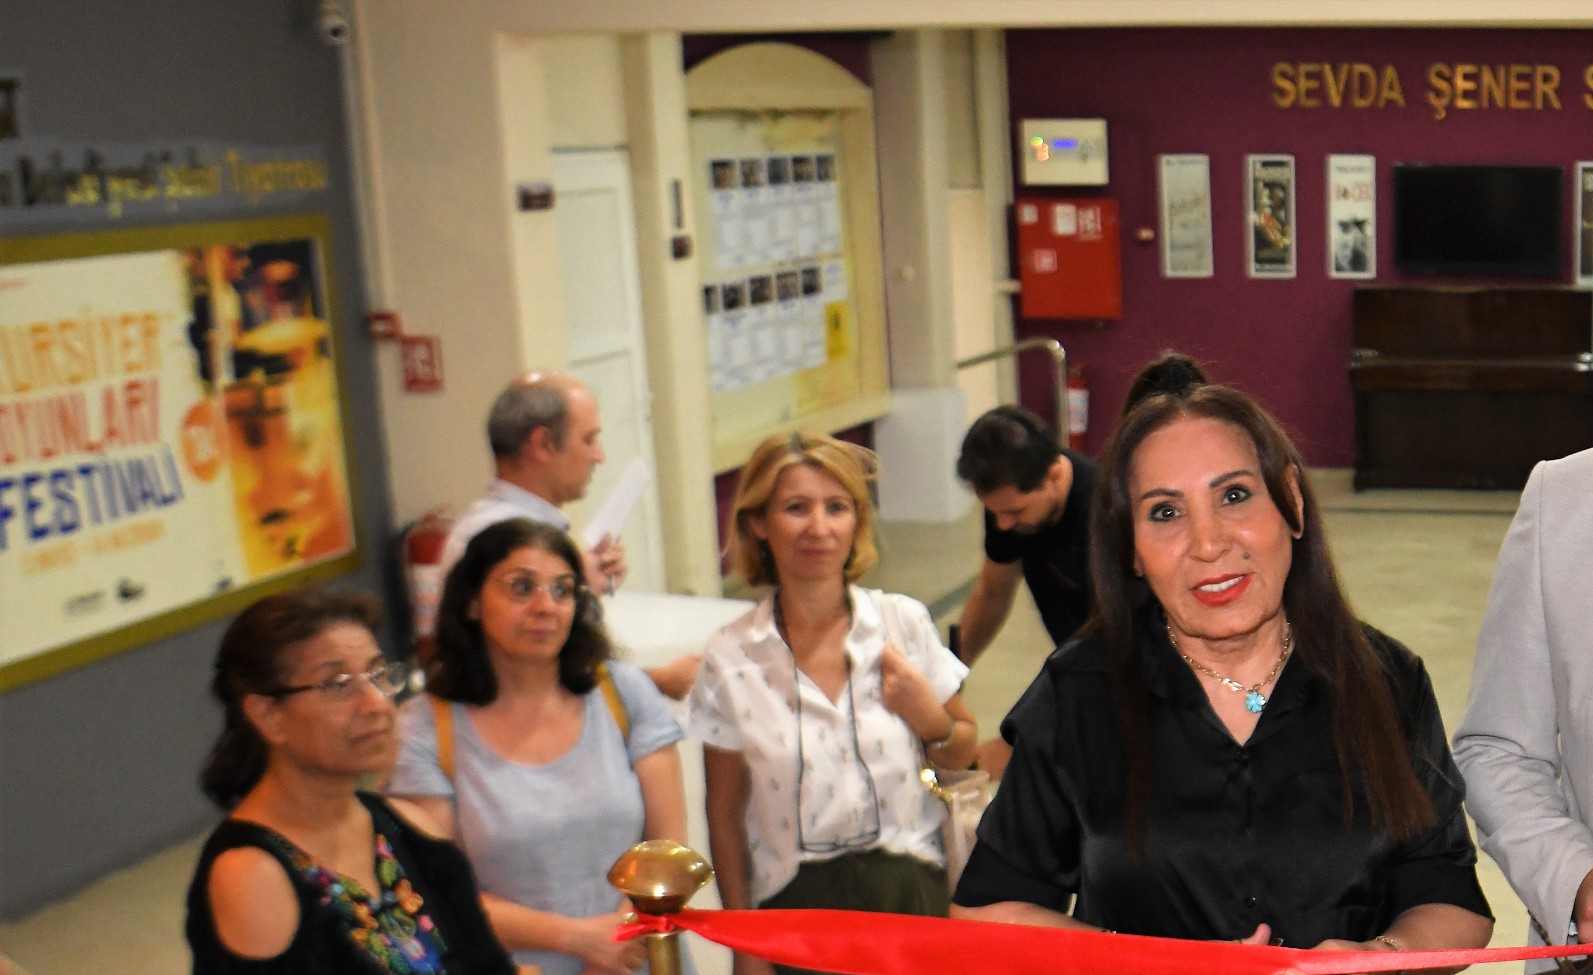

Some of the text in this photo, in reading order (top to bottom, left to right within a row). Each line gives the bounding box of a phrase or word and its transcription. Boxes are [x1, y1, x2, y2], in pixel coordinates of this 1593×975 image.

[1272, 61, 1405, 108] SEVDA
[1427, 62, 1563, 120] ŞENER
[0, 303, 165, 396] URSİYER
